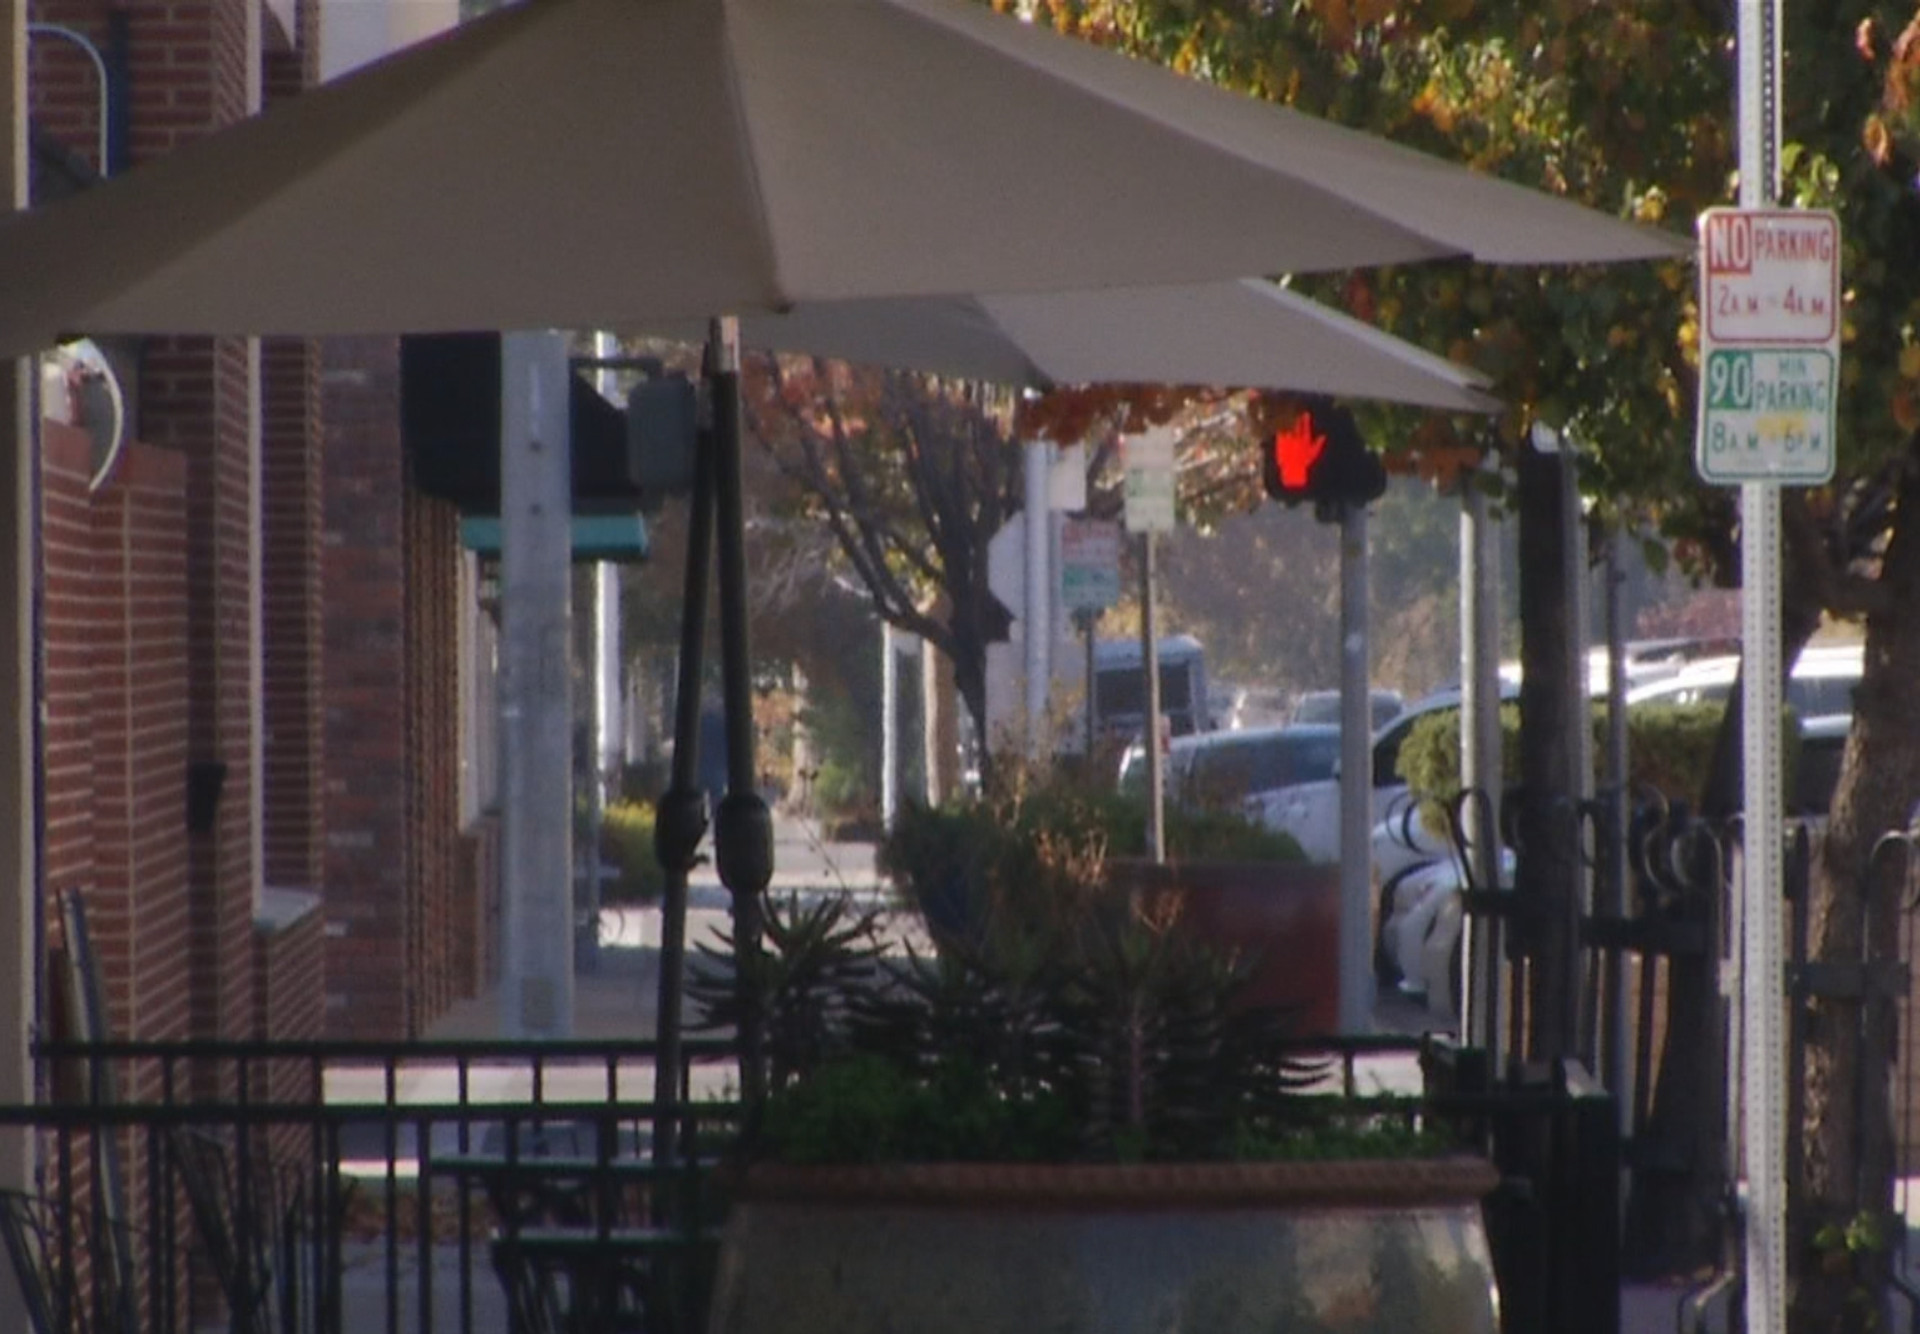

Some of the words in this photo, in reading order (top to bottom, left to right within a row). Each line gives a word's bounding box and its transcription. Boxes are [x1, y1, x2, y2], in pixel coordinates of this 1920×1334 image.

[1710, 217, 1750, 269] NO
[1755, 226, 1831, 263] PARKING
[1710, 355, 1751, 406] 90
[1754, 378, 1828, 414] PARKING
